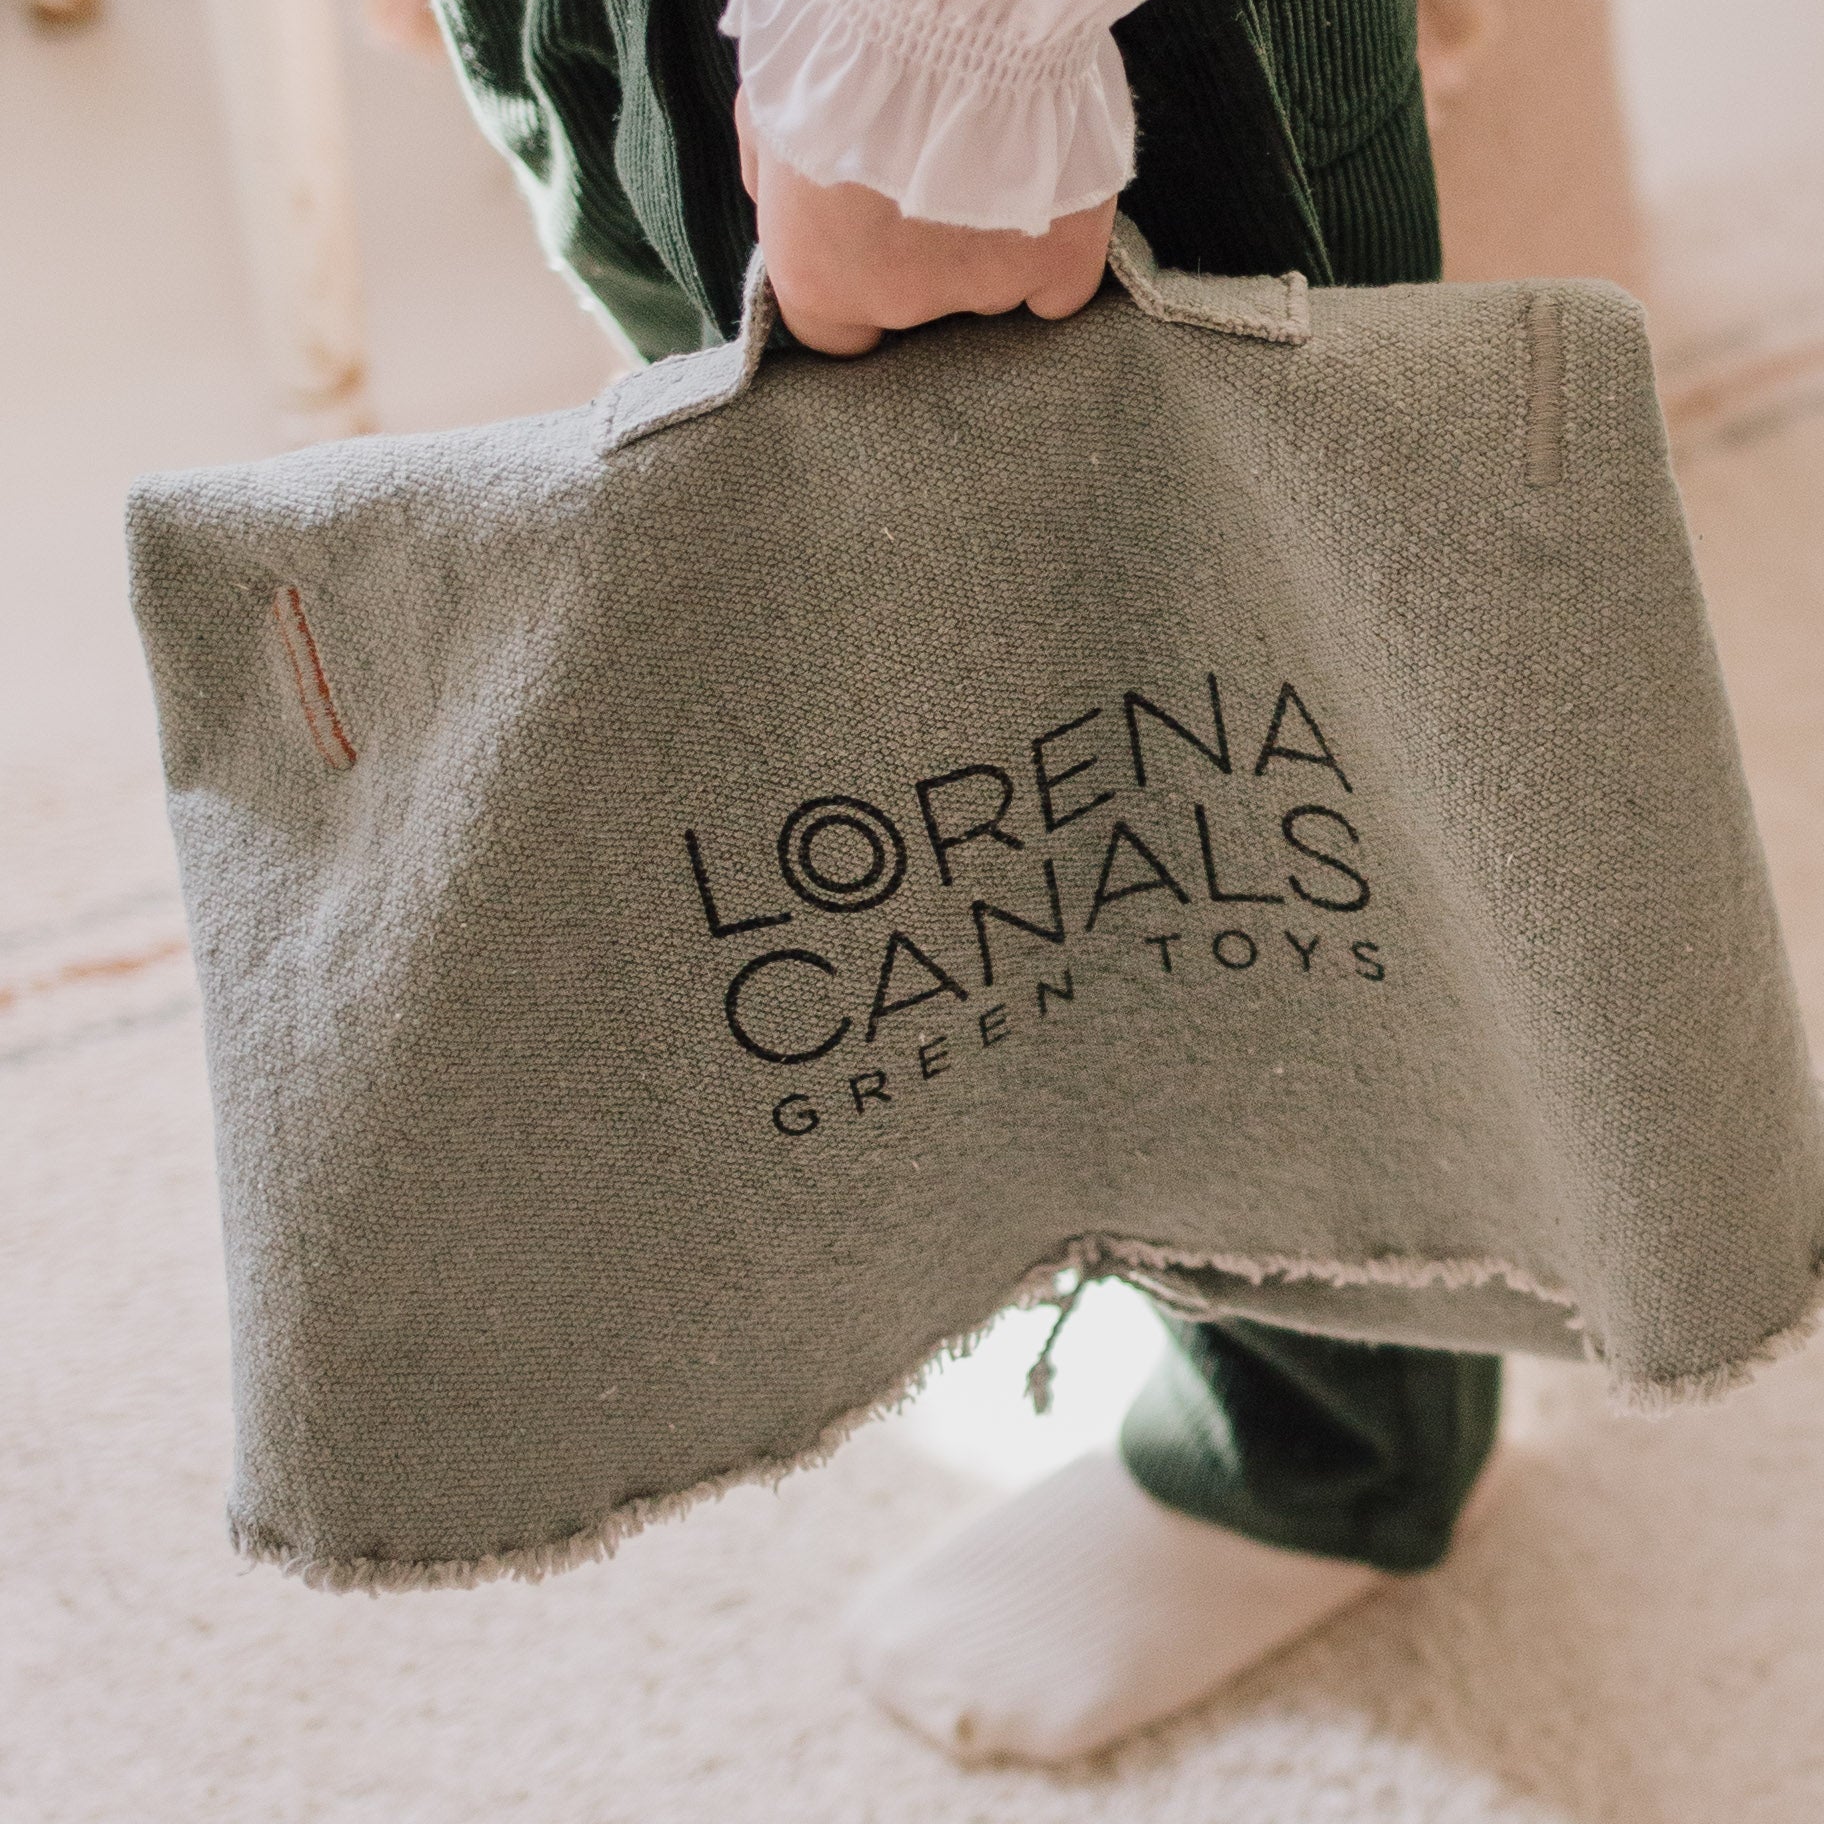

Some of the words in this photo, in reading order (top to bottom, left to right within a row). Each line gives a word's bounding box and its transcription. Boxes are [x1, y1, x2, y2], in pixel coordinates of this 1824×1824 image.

[685, 672, 1354, 939] LORENA
[725, 803, 1371, 1064] CANALS
[771, 968, 1075, 1136] GREEN
[1144, 928, 1387, 981] TOYS
